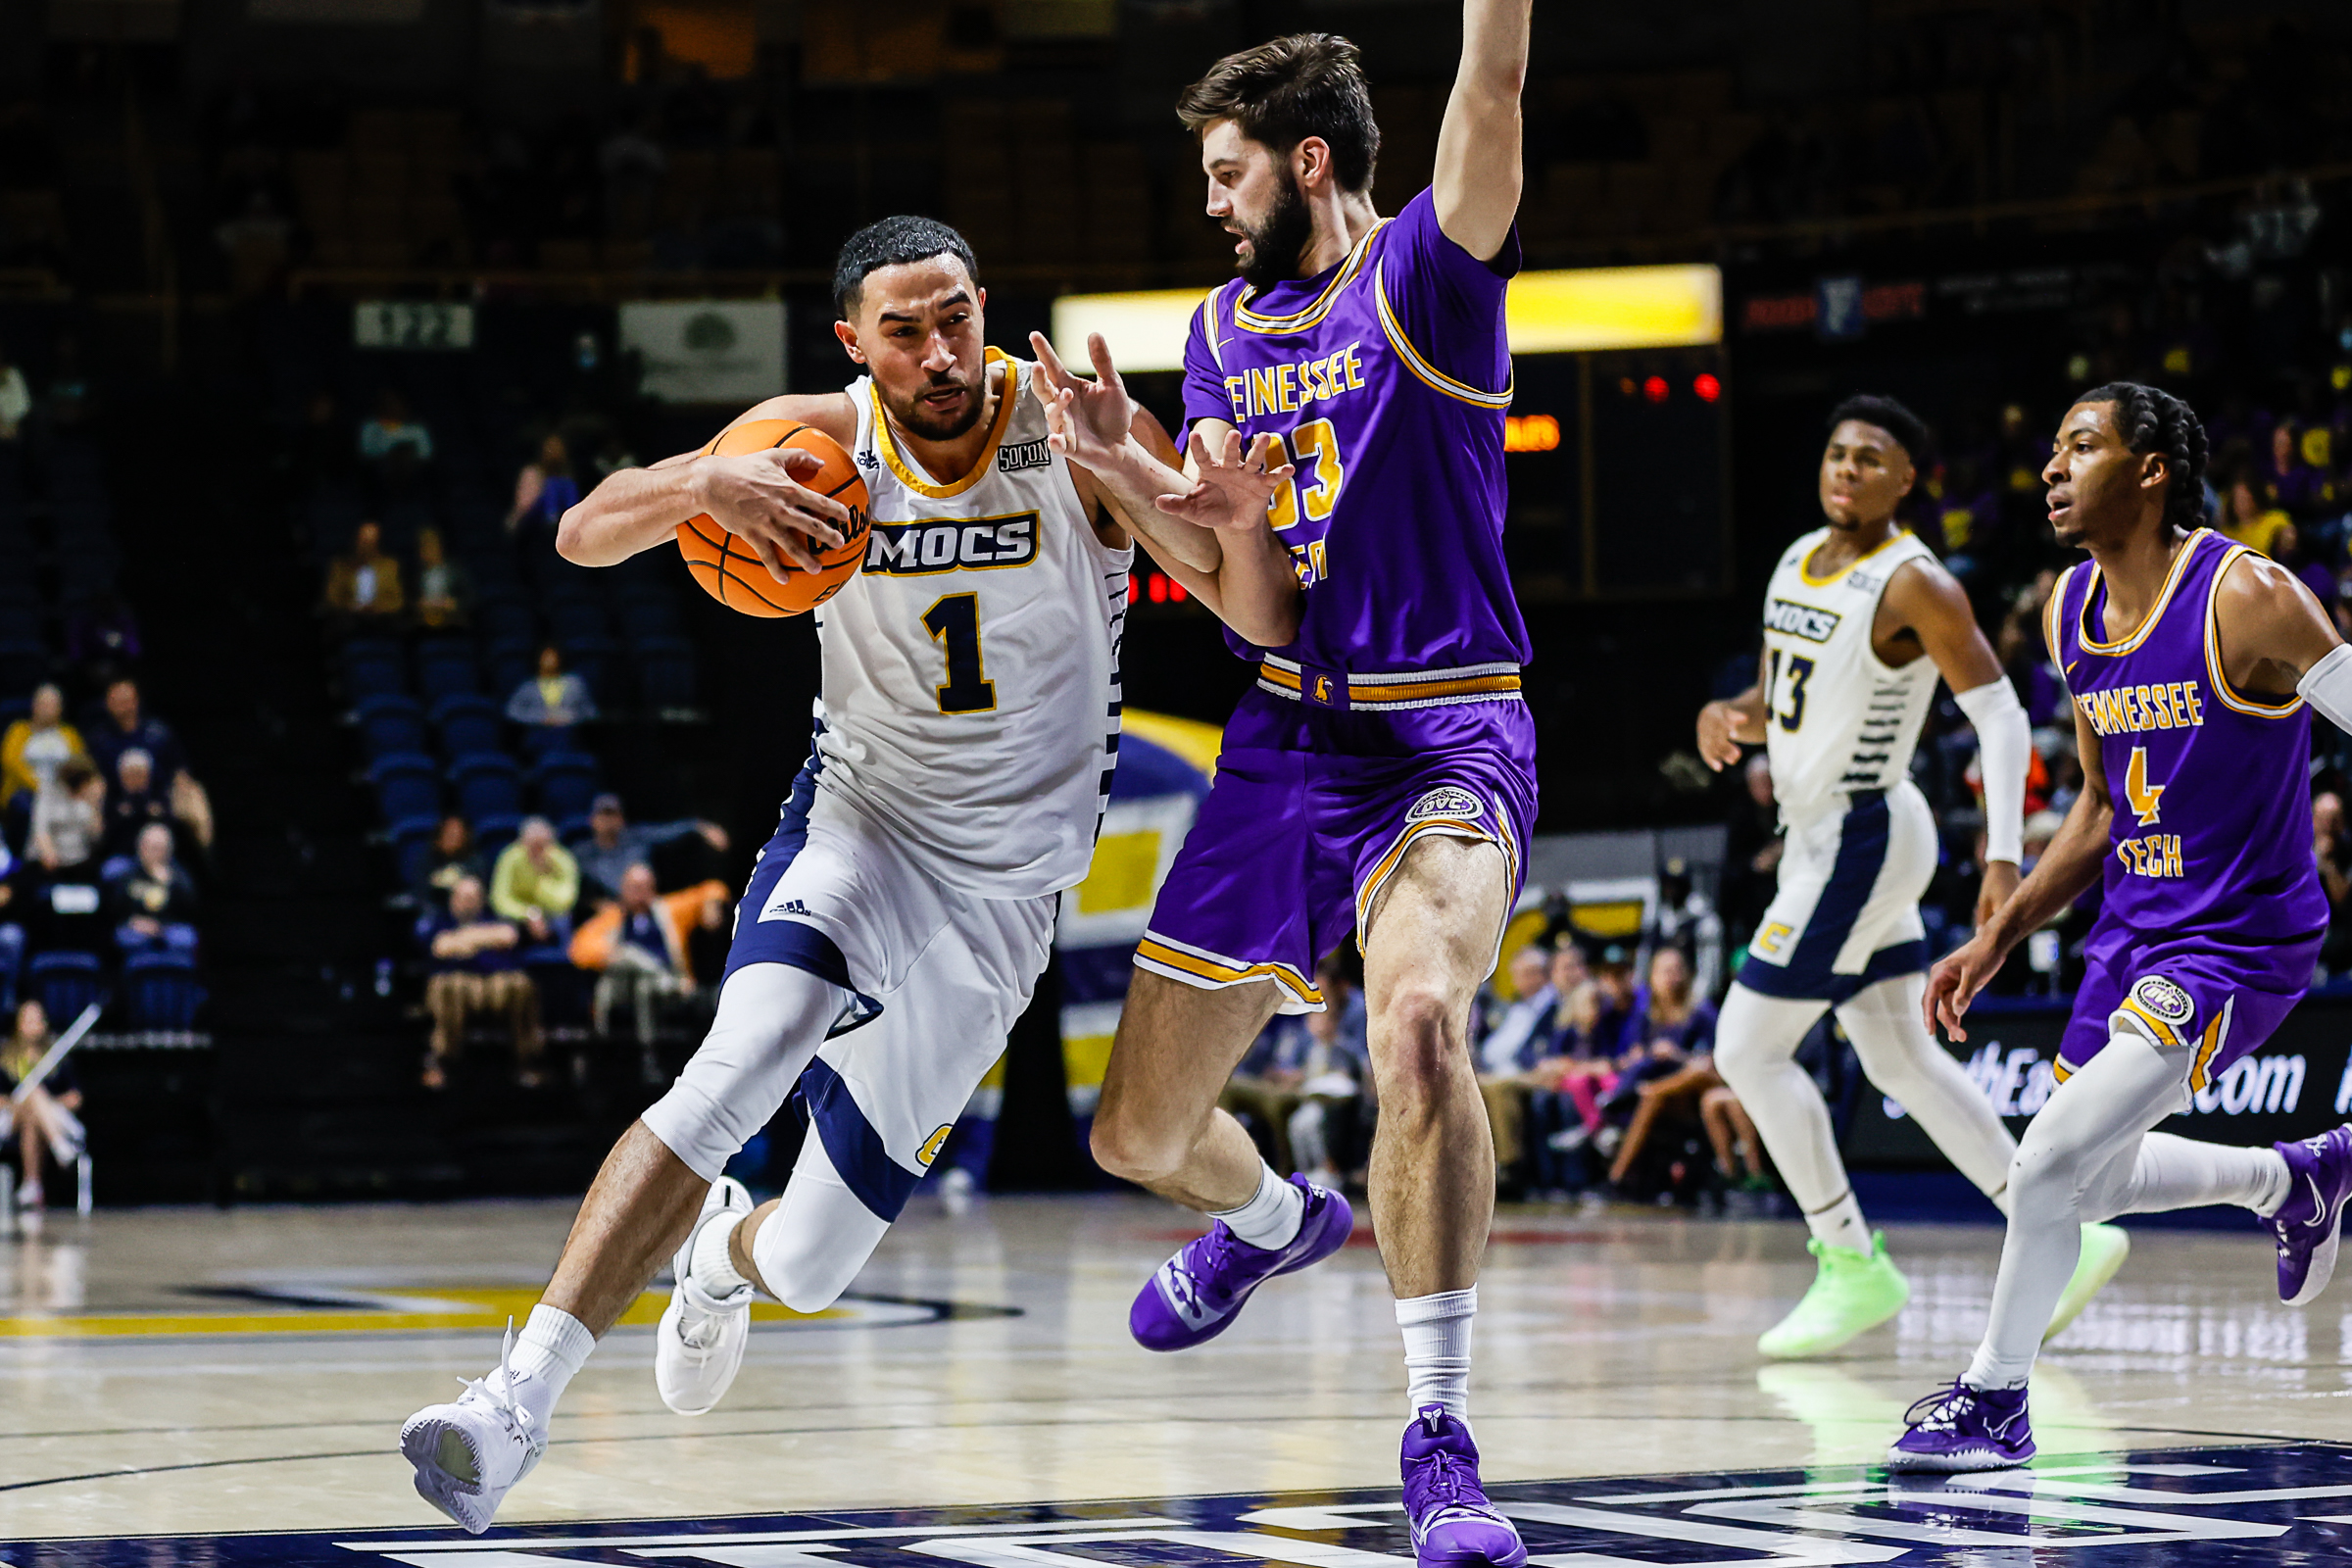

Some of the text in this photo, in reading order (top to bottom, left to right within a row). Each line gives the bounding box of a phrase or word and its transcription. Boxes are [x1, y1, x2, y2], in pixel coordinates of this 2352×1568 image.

[866, 520, 1031, 568] MOCS
[919, 591, 997, 715] 1
[1766, 603, 1838, 642] MOCS
[2125, 746, 2166, 828] 4
